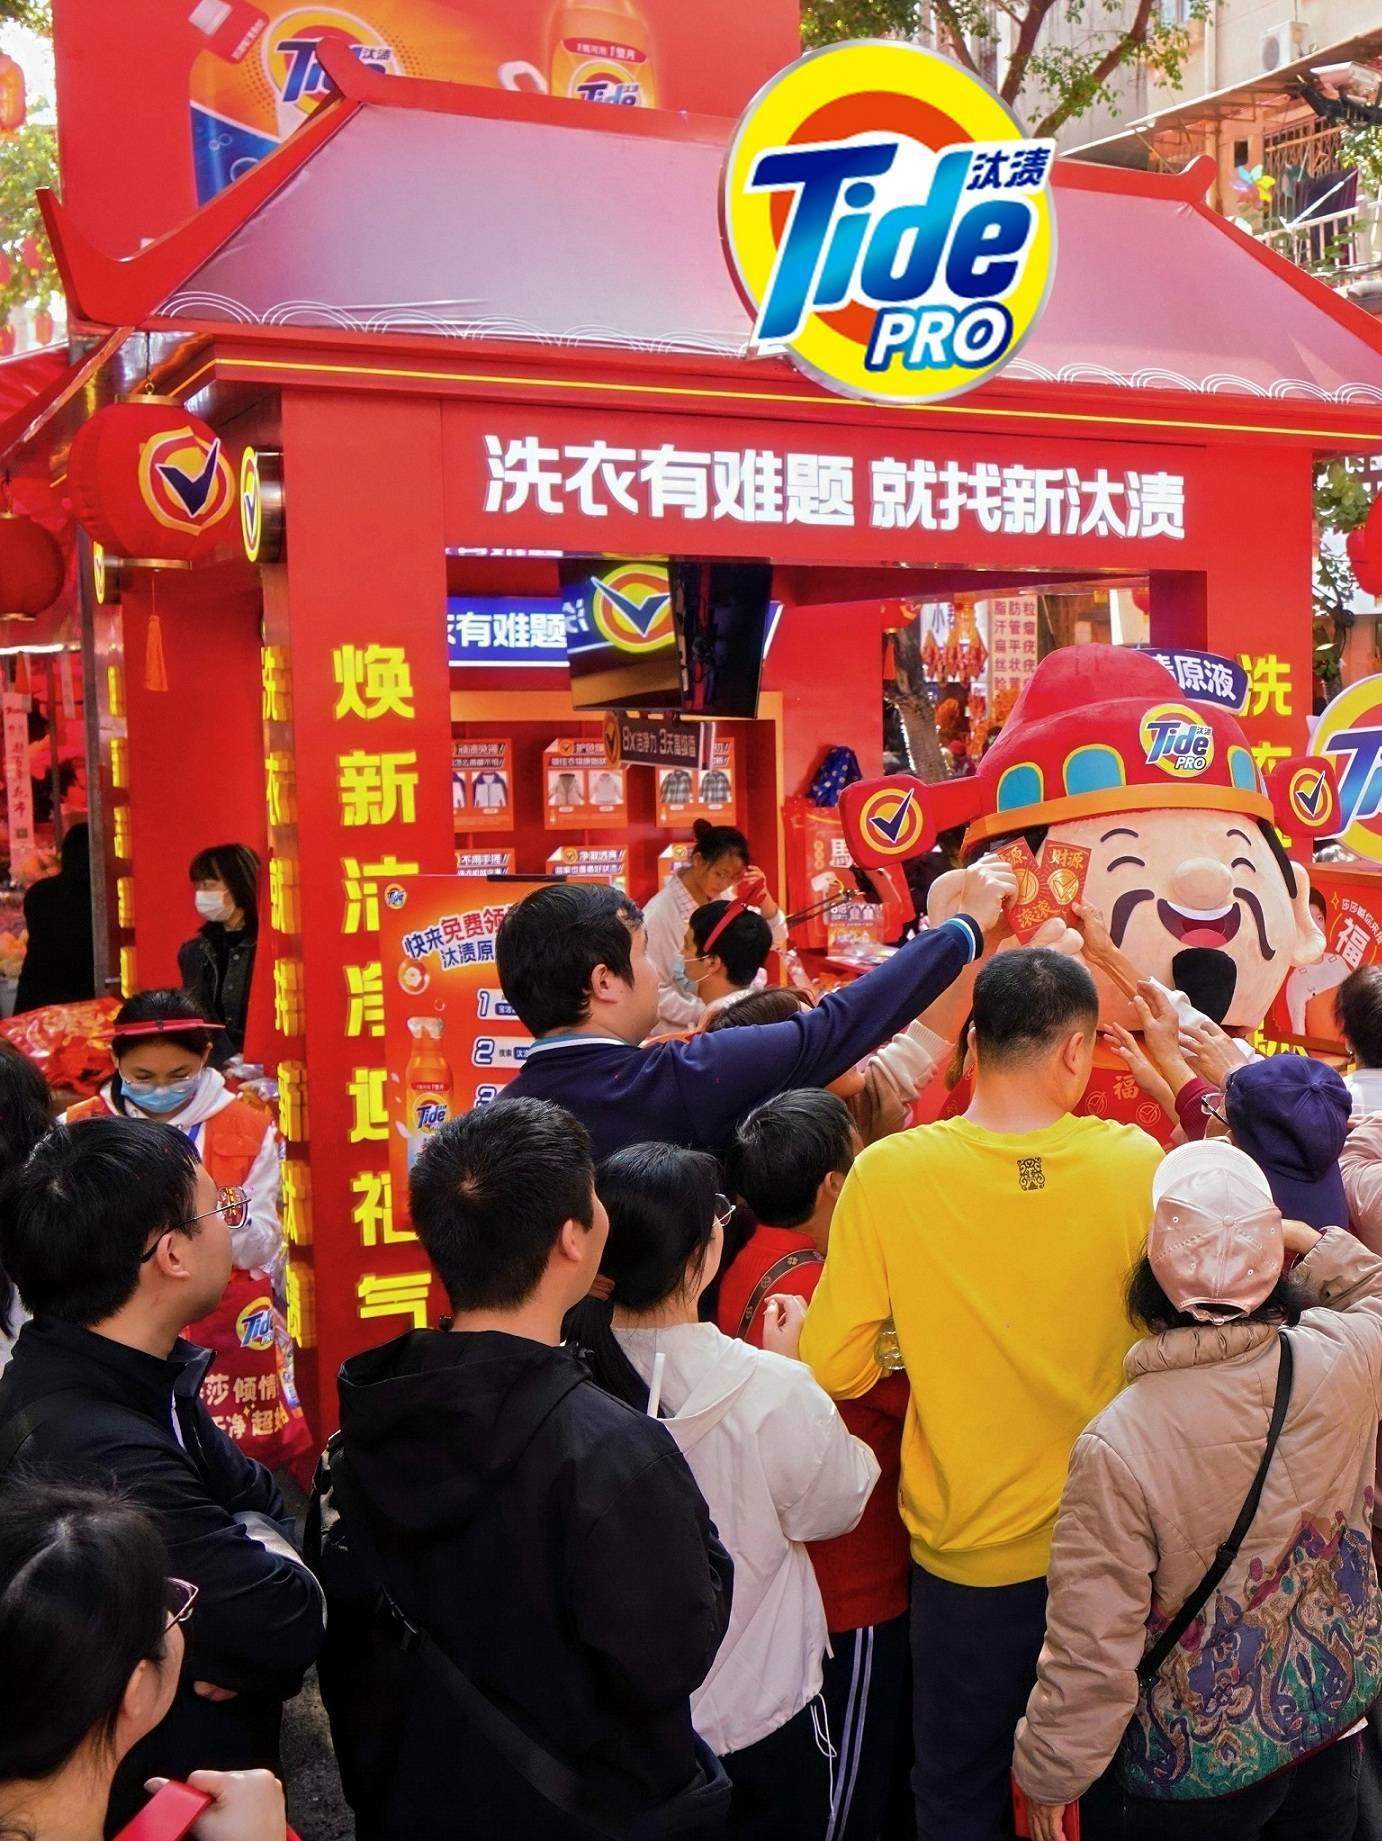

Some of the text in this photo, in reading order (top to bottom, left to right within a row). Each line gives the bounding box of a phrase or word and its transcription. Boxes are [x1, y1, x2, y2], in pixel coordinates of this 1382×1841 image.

[966, 147, 1050, 191] 汰渍
[751, 141, 1032, 341] Tide
[864, 300, 1013, 372] PRO
[483, 434, 1186, 540] 洗衣有难题 就找新汰渍
[1146, 722, 1210, 763] Tide
[1174, 756, 1207, 771] PRO
[1335, 916, 1371, 969] 福
[416, 1105, 446, 1129] Tide
[200, 1373, 278, 1407] 莎倾情
